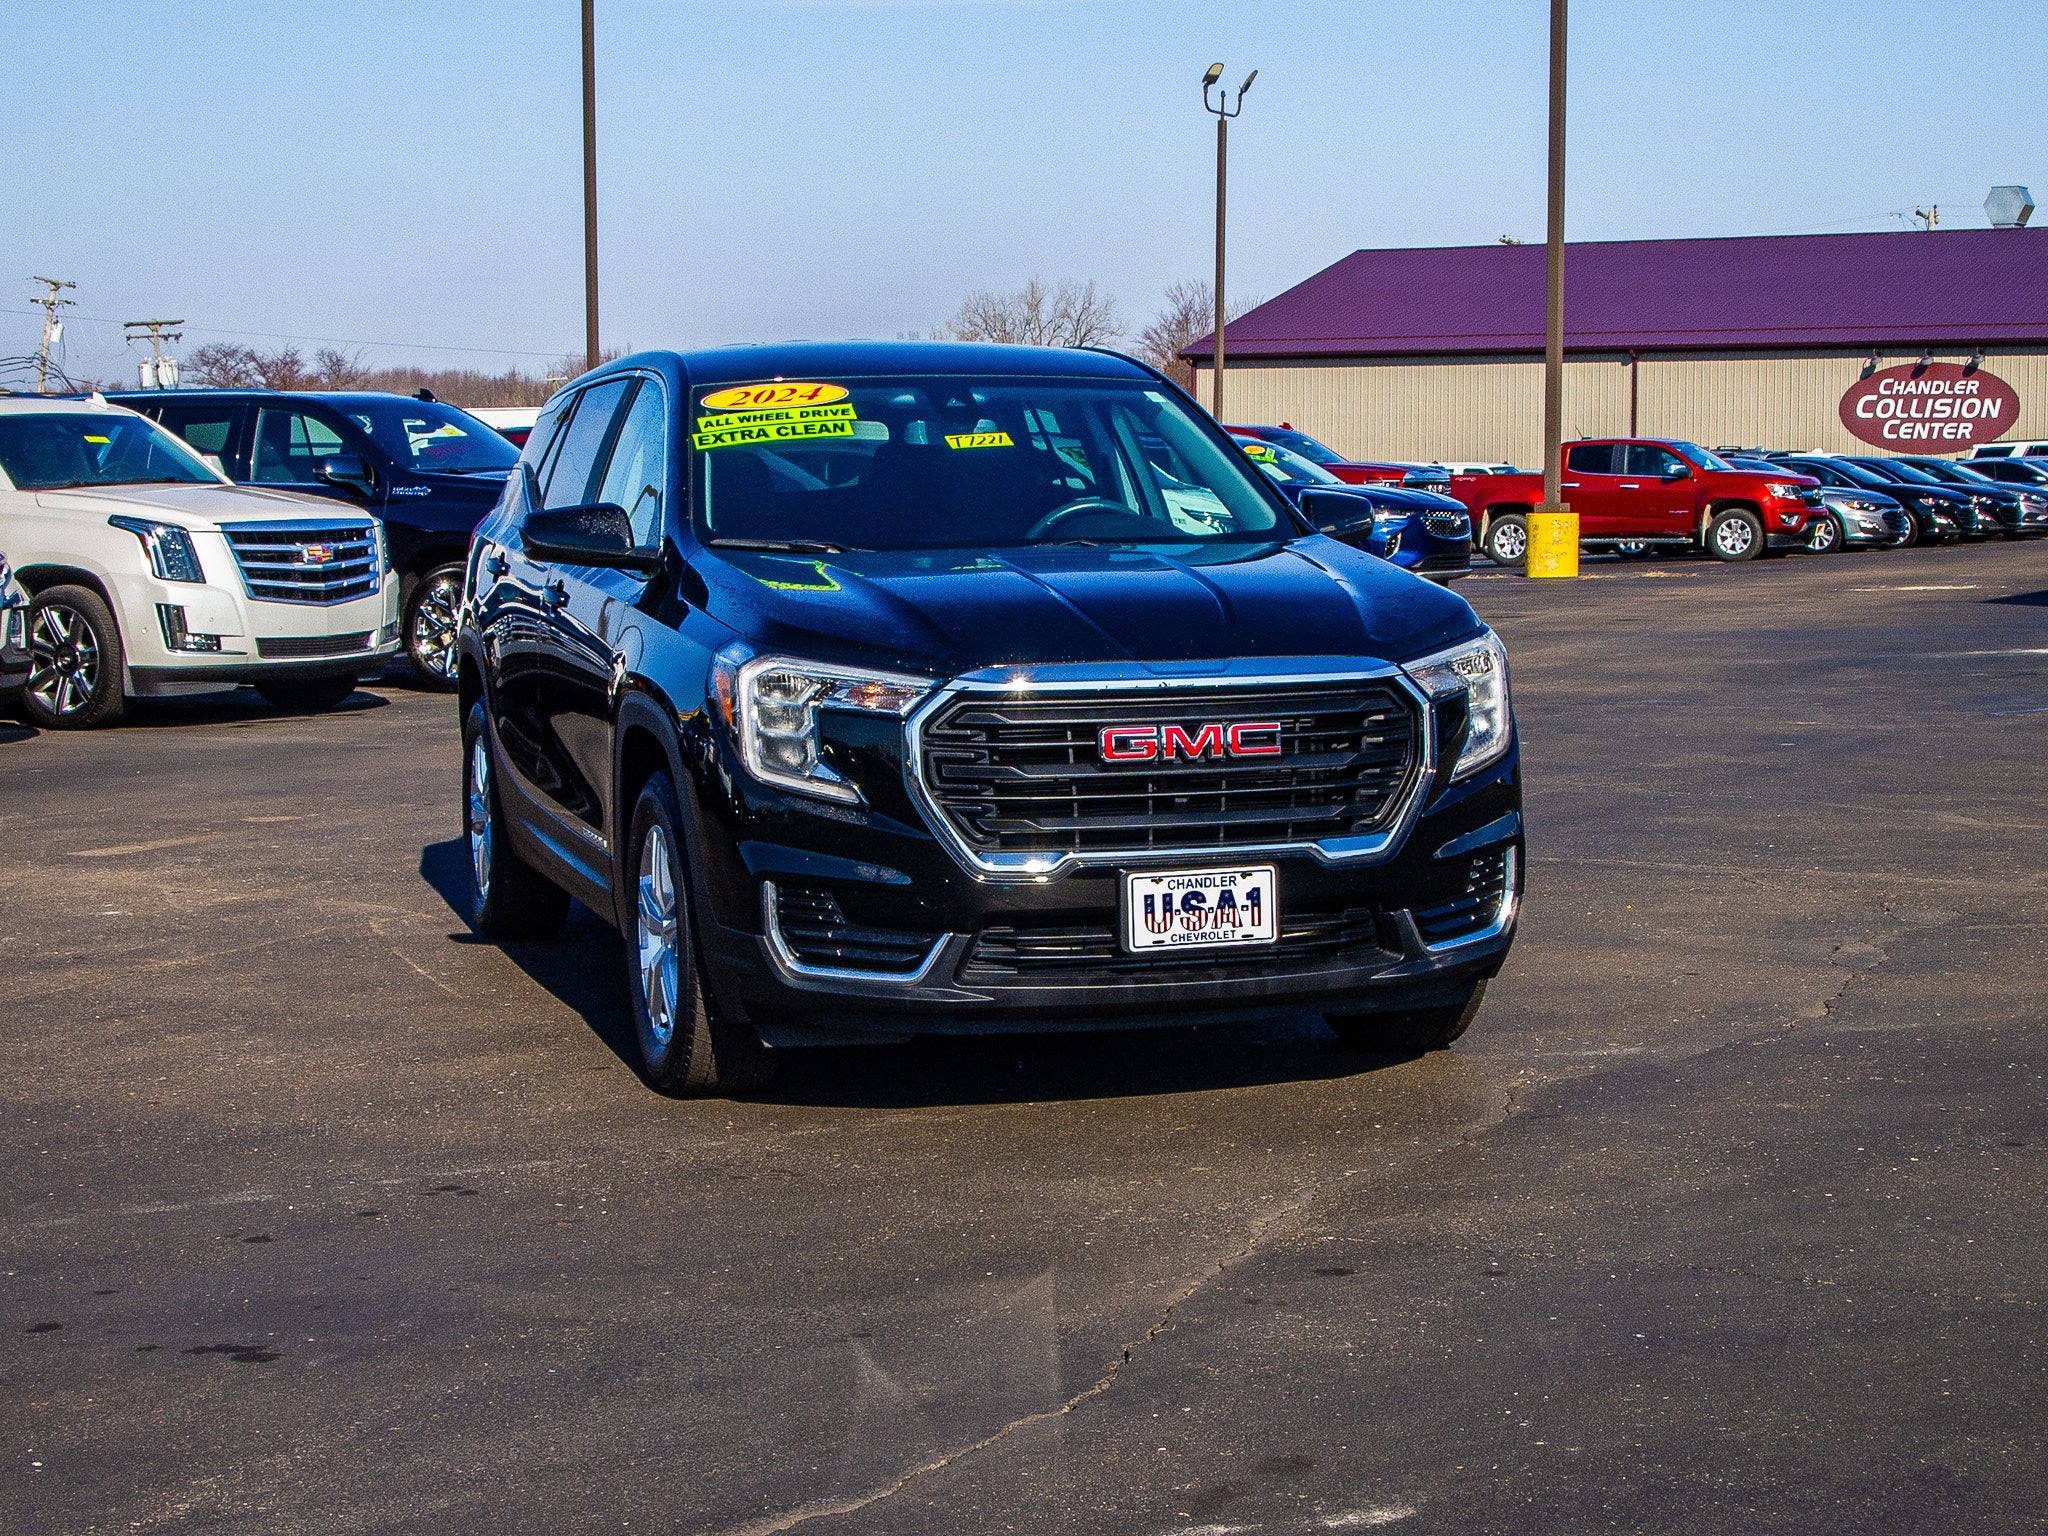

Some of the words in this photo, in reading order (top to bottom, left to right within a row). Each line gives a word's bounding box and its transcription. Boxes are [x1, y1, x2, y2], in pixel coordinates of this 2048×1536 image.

[728, 386, 824, 407] 2024
[1878, 378, 1980, 395] CHANDLER
[1855, 394, 2003, 419] COLLISION
[703, 418, 734, 429] ALL
[737, 411, 794, 423] WHEEL
[799, 407, 851, 419] DRIVE
[697, 427, 769, 447] EXTRA
[775, 421, 846, 438] CLEAN
[1882, 419, 1974, 440] CENTER
[949, 434, 1004, 448] T7221
[1099, 722, 1282, 762] GMC
[1167, 876, 1237, 890] CHANDLER
[1170, 930, 1236, 943] CHEVROLET
